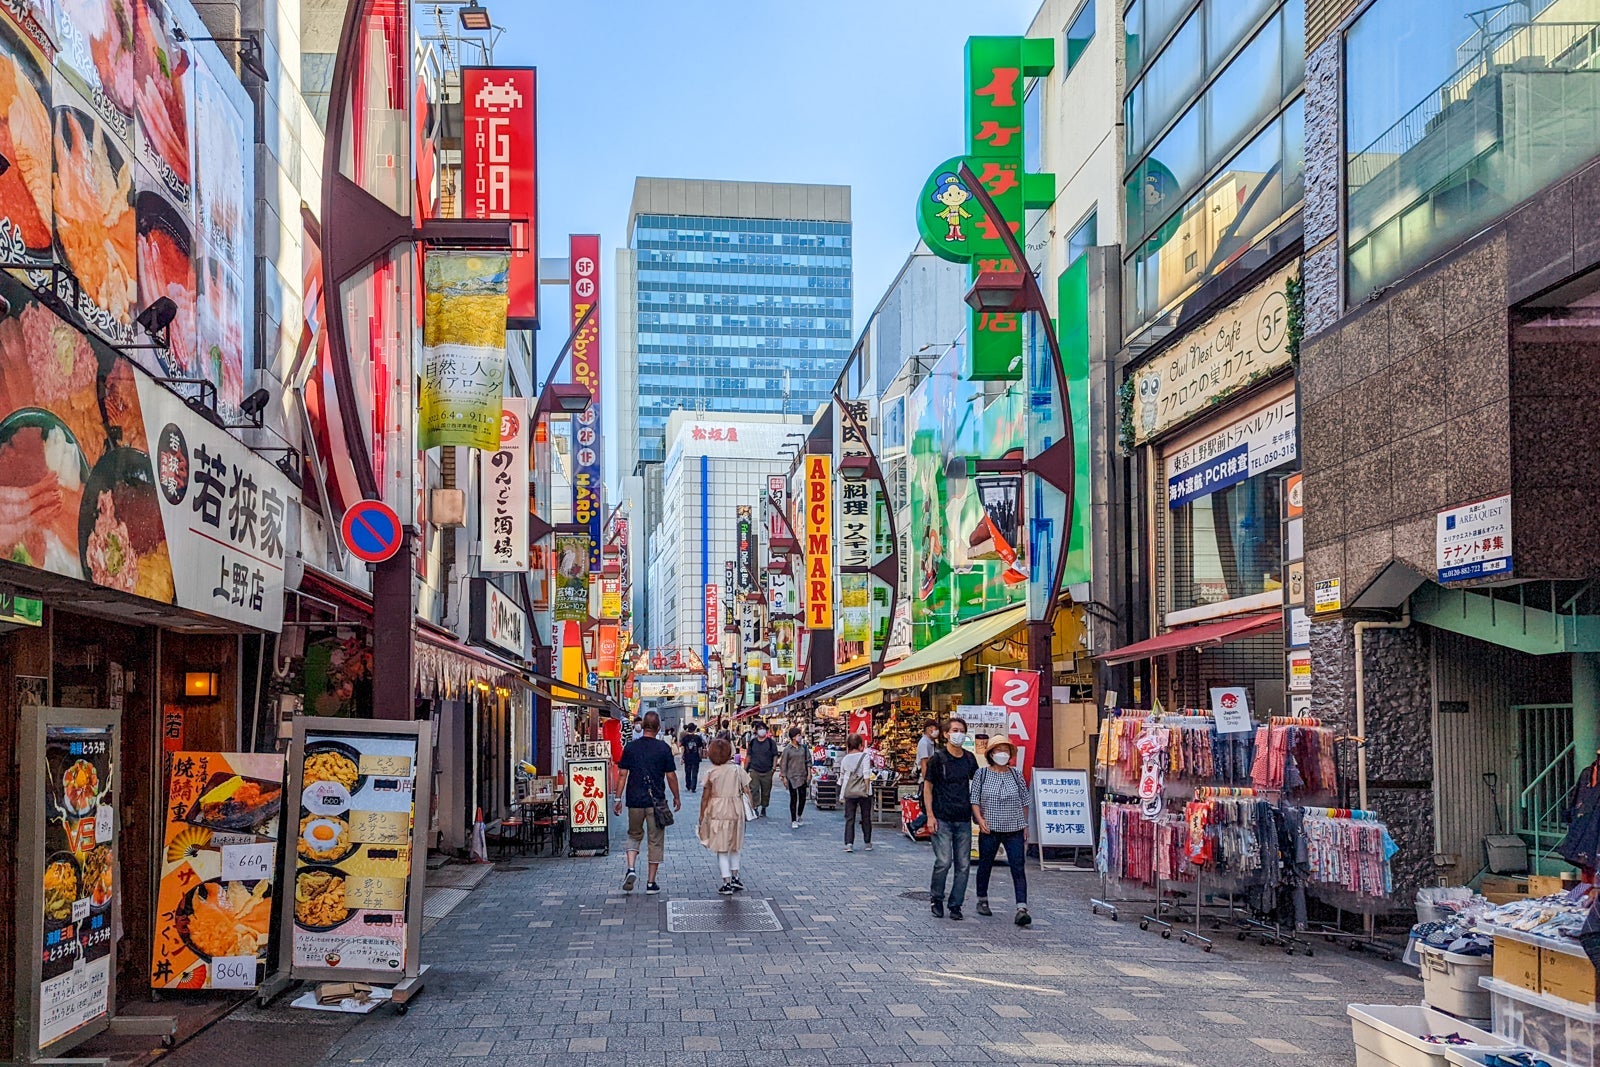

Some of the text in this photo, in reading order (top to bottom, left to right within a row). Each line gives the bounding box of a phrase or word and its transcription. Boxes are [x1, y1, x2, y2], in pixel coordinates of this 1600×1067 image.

[475, 118, 485, 193] TAITO
[974, 67, 1021, 332] イケダヤ店
[578, 261, 592, 272] 5F
[578, 282, 592, 293] 4F
[1262, 306, 1284, 341] 3F
[1170, 357, 1187, 382] Owl
[1216, 320, 1242, 353] Café
[426, 358, 502, 380] 自然と人の
[424, 377, 503, 393] ダイアローグ
[1161, 350, 1254, 416] フクロウの巣カフェ
[469, 411, 488, 424] 9.11
[580, 431, 592, 441] 2F
[692, 426, 738, 442] 松坂屋
[580, 452, 592, 463] 1F
[1251, 443, 1296, 470] TEL.050-318
[193, 443, 284, 560] 若狭家
[576, 473, 590, 524] HARD
[1459, 506, 1503, 525] AREA QUEST
[740, 524, 749, 550] Friendly
[1443, 535, 1504, 560] テナント募集
[213, 554, 265, 613] 上野店
[706, 586, 717, 643] スギドラッグ
[170, 756, 195, 823] 焼鯖重
[1041, 778, 1081, 786] 東京上野駅前
[64, 816, 97, 854] VS
[1045, 823, 1085, 834] 予約不要
[239, 855, 267, 872] 660円
[153, 910, 176, 982] づくし丼
[216, 962, 248, 980] 860円
